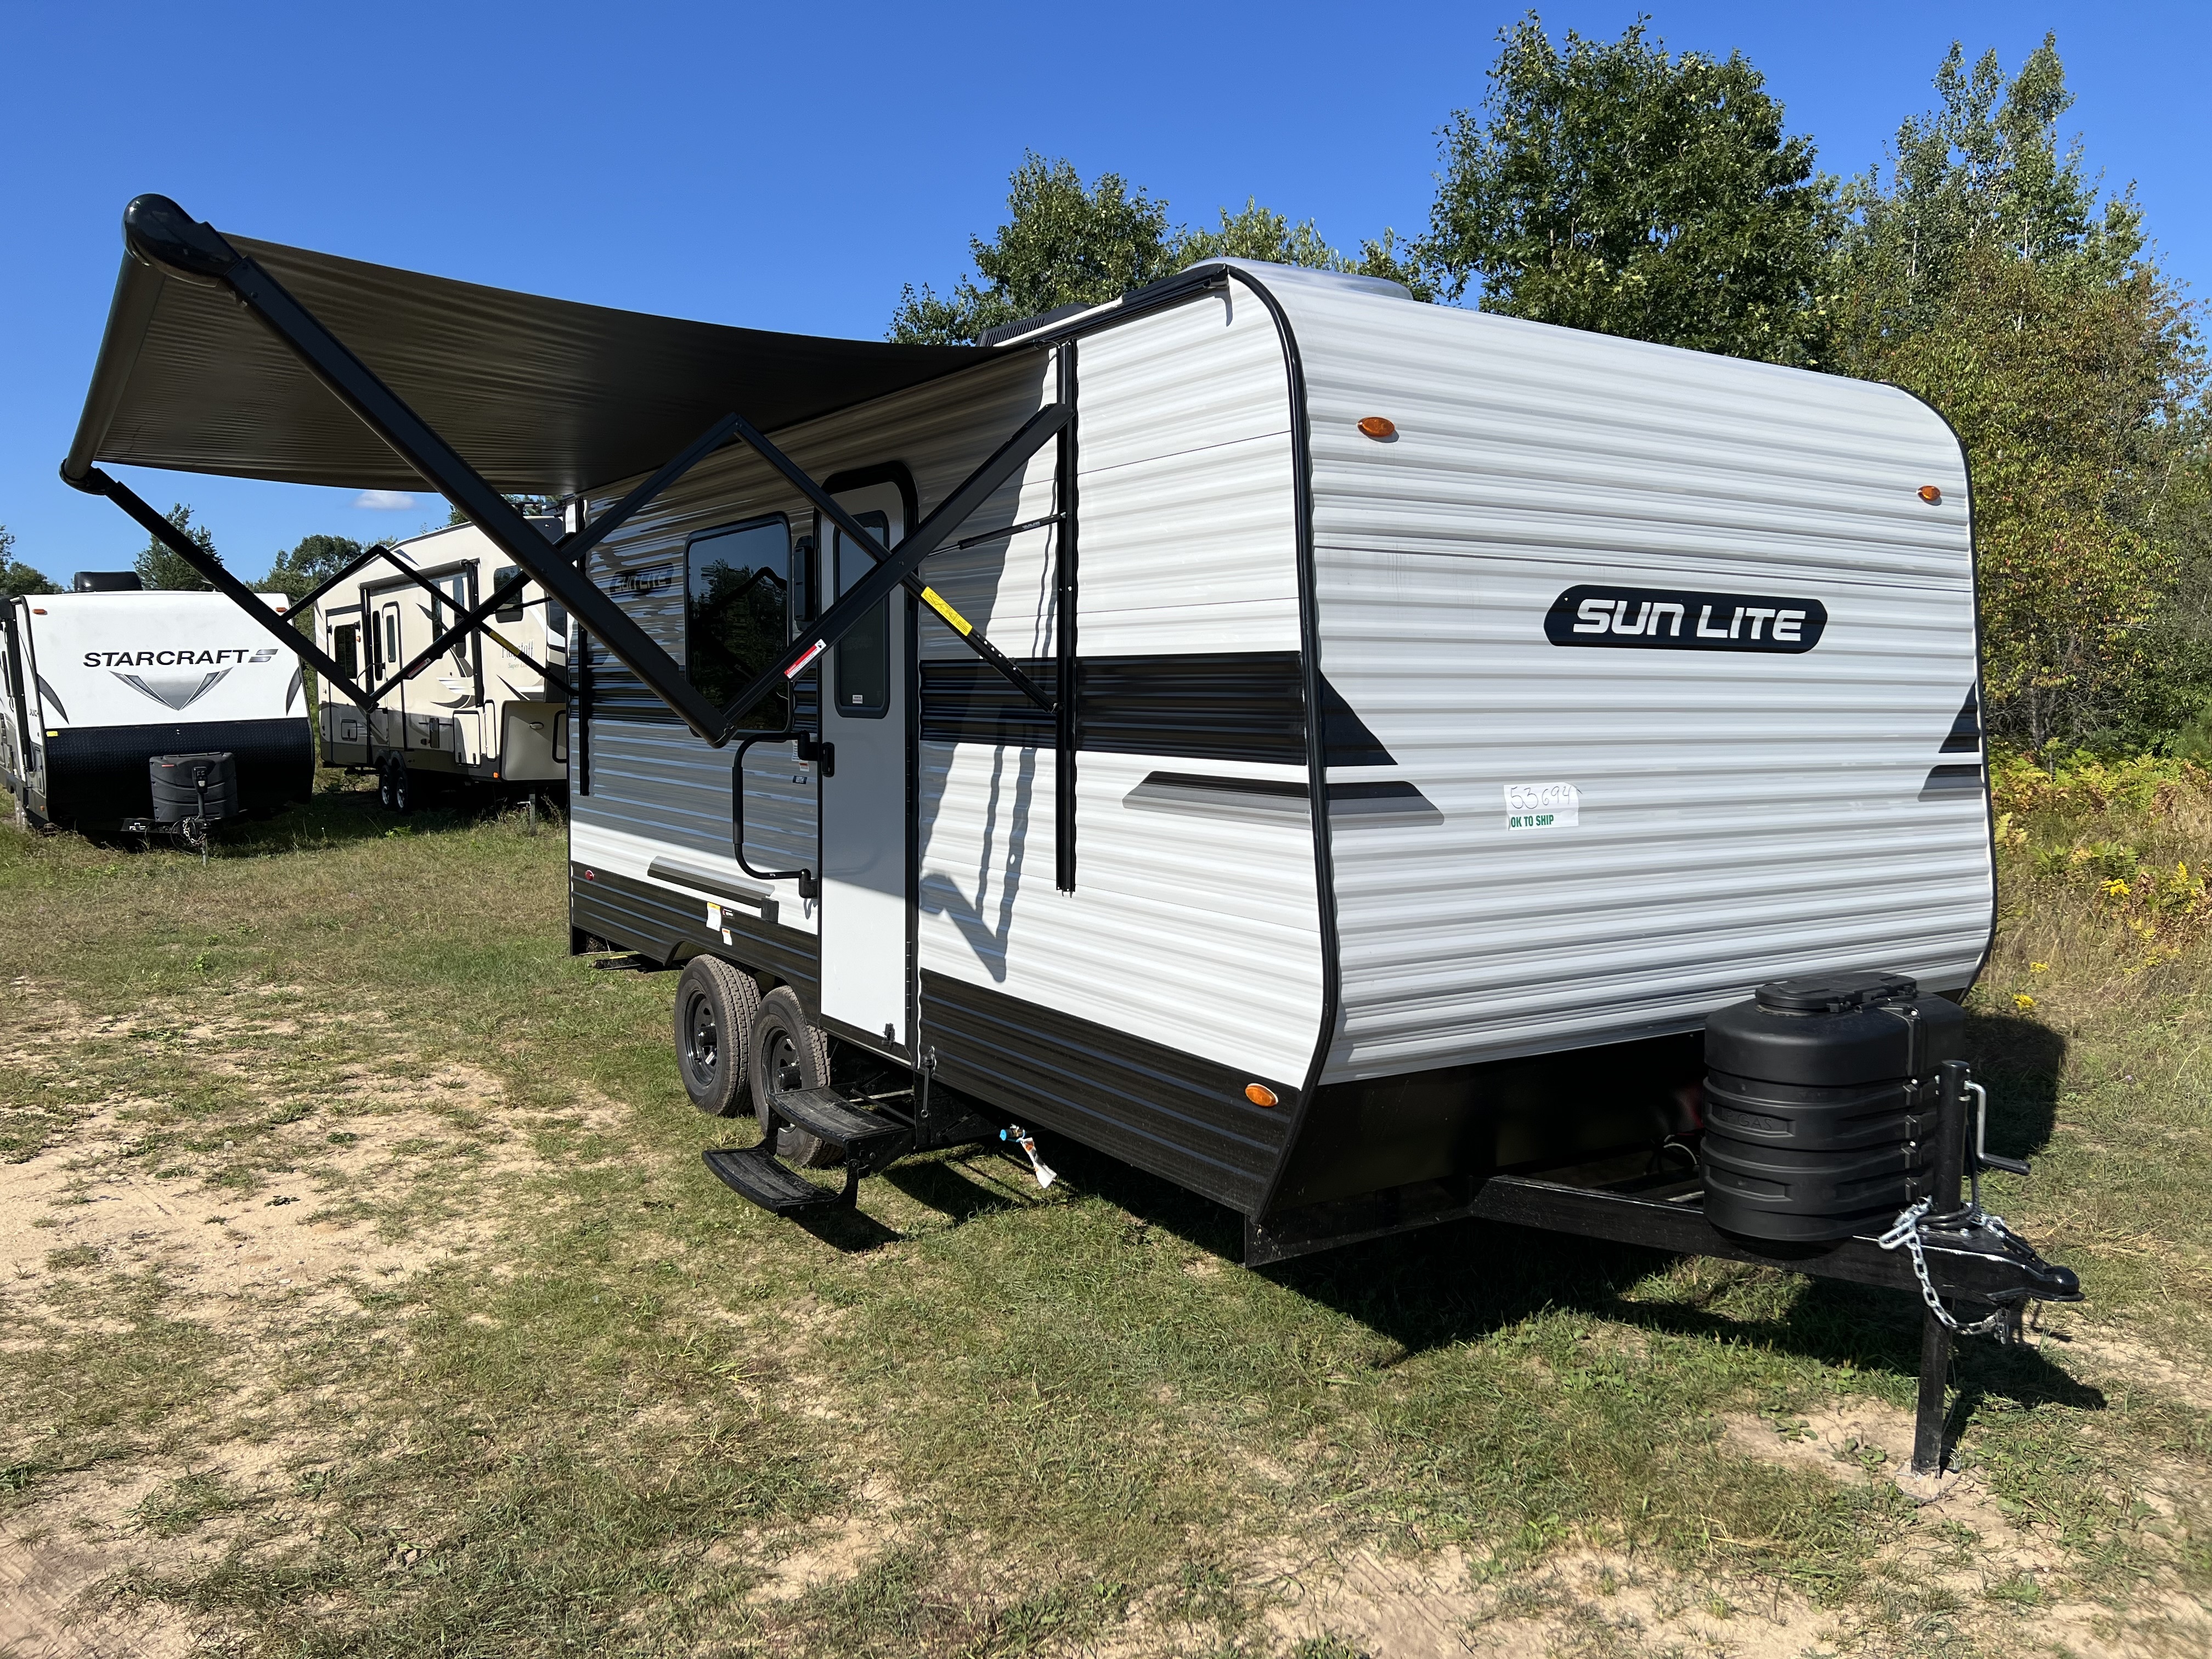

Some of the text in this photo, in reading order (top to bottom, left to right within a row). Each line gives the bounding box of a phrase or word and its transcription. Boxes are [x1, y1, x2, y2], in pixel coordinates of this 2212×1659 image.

[1573, 599, 1807, 641] SUN LITE
[82, 649, 250, 668] STARCRAFT
[1510, 786, 1572, 809] 53694
[1510, 814, 1554, 827] OK TO SHIP
[1737, 1113, 1773, 1131] GAS
